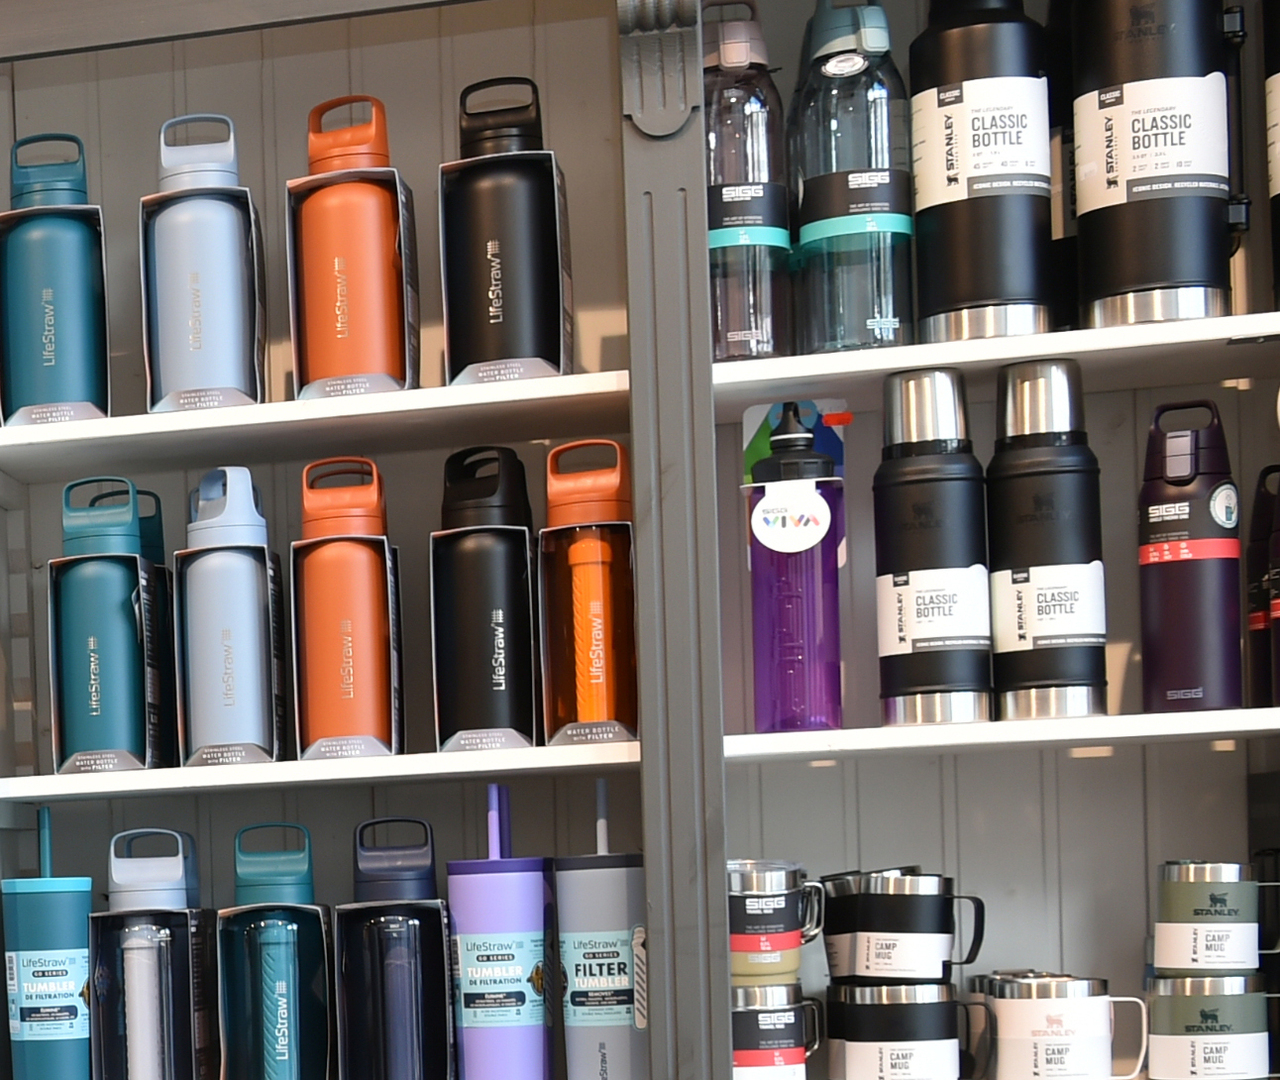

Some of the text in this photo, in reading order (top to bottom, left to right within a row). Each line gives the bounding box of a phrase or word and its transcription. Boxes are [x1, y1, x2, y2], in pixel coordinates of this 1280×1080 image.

[972, 114, 1028, 131] CLASSIC
[1131, 114, 1192, 133] CLASSIC
[945, 114, 954, 172] STANLEY
[972, 130, 1023, 148] BOTTLE
[1105, 116, 1114, 174] STANLEY
[1132, 131, 1186, 150] BOTTLE
[847, 172, 890, 185] SIGG
[722, 186, 764, 199] SIGG
[488, 257, 503, 325] LifeStraw
[42, 303, 55, 367] LifeStraw
[1148, 502, 1189, 517] SIGG
[762, 514, 820, 528] VIVA
[916, 593, 958, 606] CLASSIC
[1037, 591, 1079, 604] CLASSIC
[916, 605, 953, 618] BOTTLE
[1037, 603, 1075, 616] BOTTLE
[589, 616, 604, 683] LifeStraw
[492, 623, 507, 691] LifeStraw
[88, 651, 101, 716] LifeStraw
[745, 897, 785, 909] SIGG
[1193, 908, 1239, 917] STANLEY
[573, 940, 618, 950] LifeStraw
[1205, 934, 1230, 943] CAMP
[466, 941, 512, 951] LifeStraw
[875, 942, 897, 951] CAMP
[1205, 943, 1225, 952] MUG
[875, 951, 892, 960] MUG
[22, 958, 66, 968] LifeStraw
[575, 962, 628, 977] FILTER
[467, 966, 523, 977] TUMBLER
[23, 981, 75, 993] TUMBLER
[480, 978, 521, 986] FILTRATION
[575, 977, 629, 988] TUMBLER
[758, 1012, 795, 1025] SIGG
[277, 997, 289, 1061] LifeStraw
[1185, 1024, 1233, 1032] STANLEY
[890, 1052, 914, 1061] CAMP
[1045, 1047, 1070, 1056] CAMP
[1203, 1046, 1229, 1055] CAMP
[890, 1061, 909, 1070] MUG
[1046, 1057, 1065, 1065] MUG
[1203, 1055, 1224, 1064] MUG
